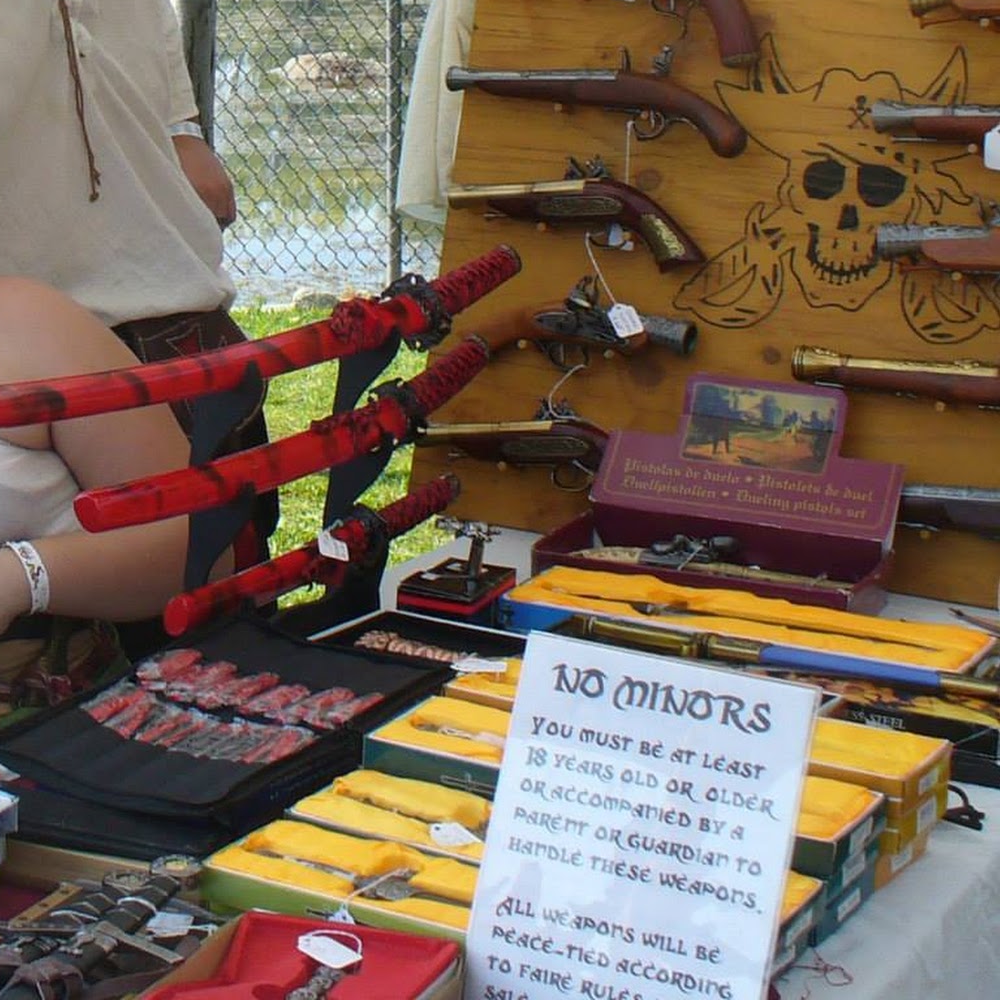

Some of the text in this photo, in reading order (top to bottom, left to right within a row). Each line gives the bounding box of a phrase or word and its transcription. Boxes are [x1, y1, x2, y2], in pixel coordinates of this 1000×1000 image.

[552, 663, 772, 734] NO MINORS
[531, 716, 767, 780] YOU MUST BE AT LEAST
[520, 777, 746, 841] OR ACCOMPANIED BY A
[525, 746, 782, 822] 18 YEARS OLD OR OLDER
[507, 836, 764, 915] HANDLE THESE WEAPONS.
[513, 807, 763, 877] PARENT OR GUARDIAN TO
[491, 925, 733, 1000] PEACE-TIED ACCORDING
[495, 896, 721, 964] ALL WEAPONS WILL BE
[486, 955, 512, 974] TO
[519, 963, 574, 995] FAIRE
